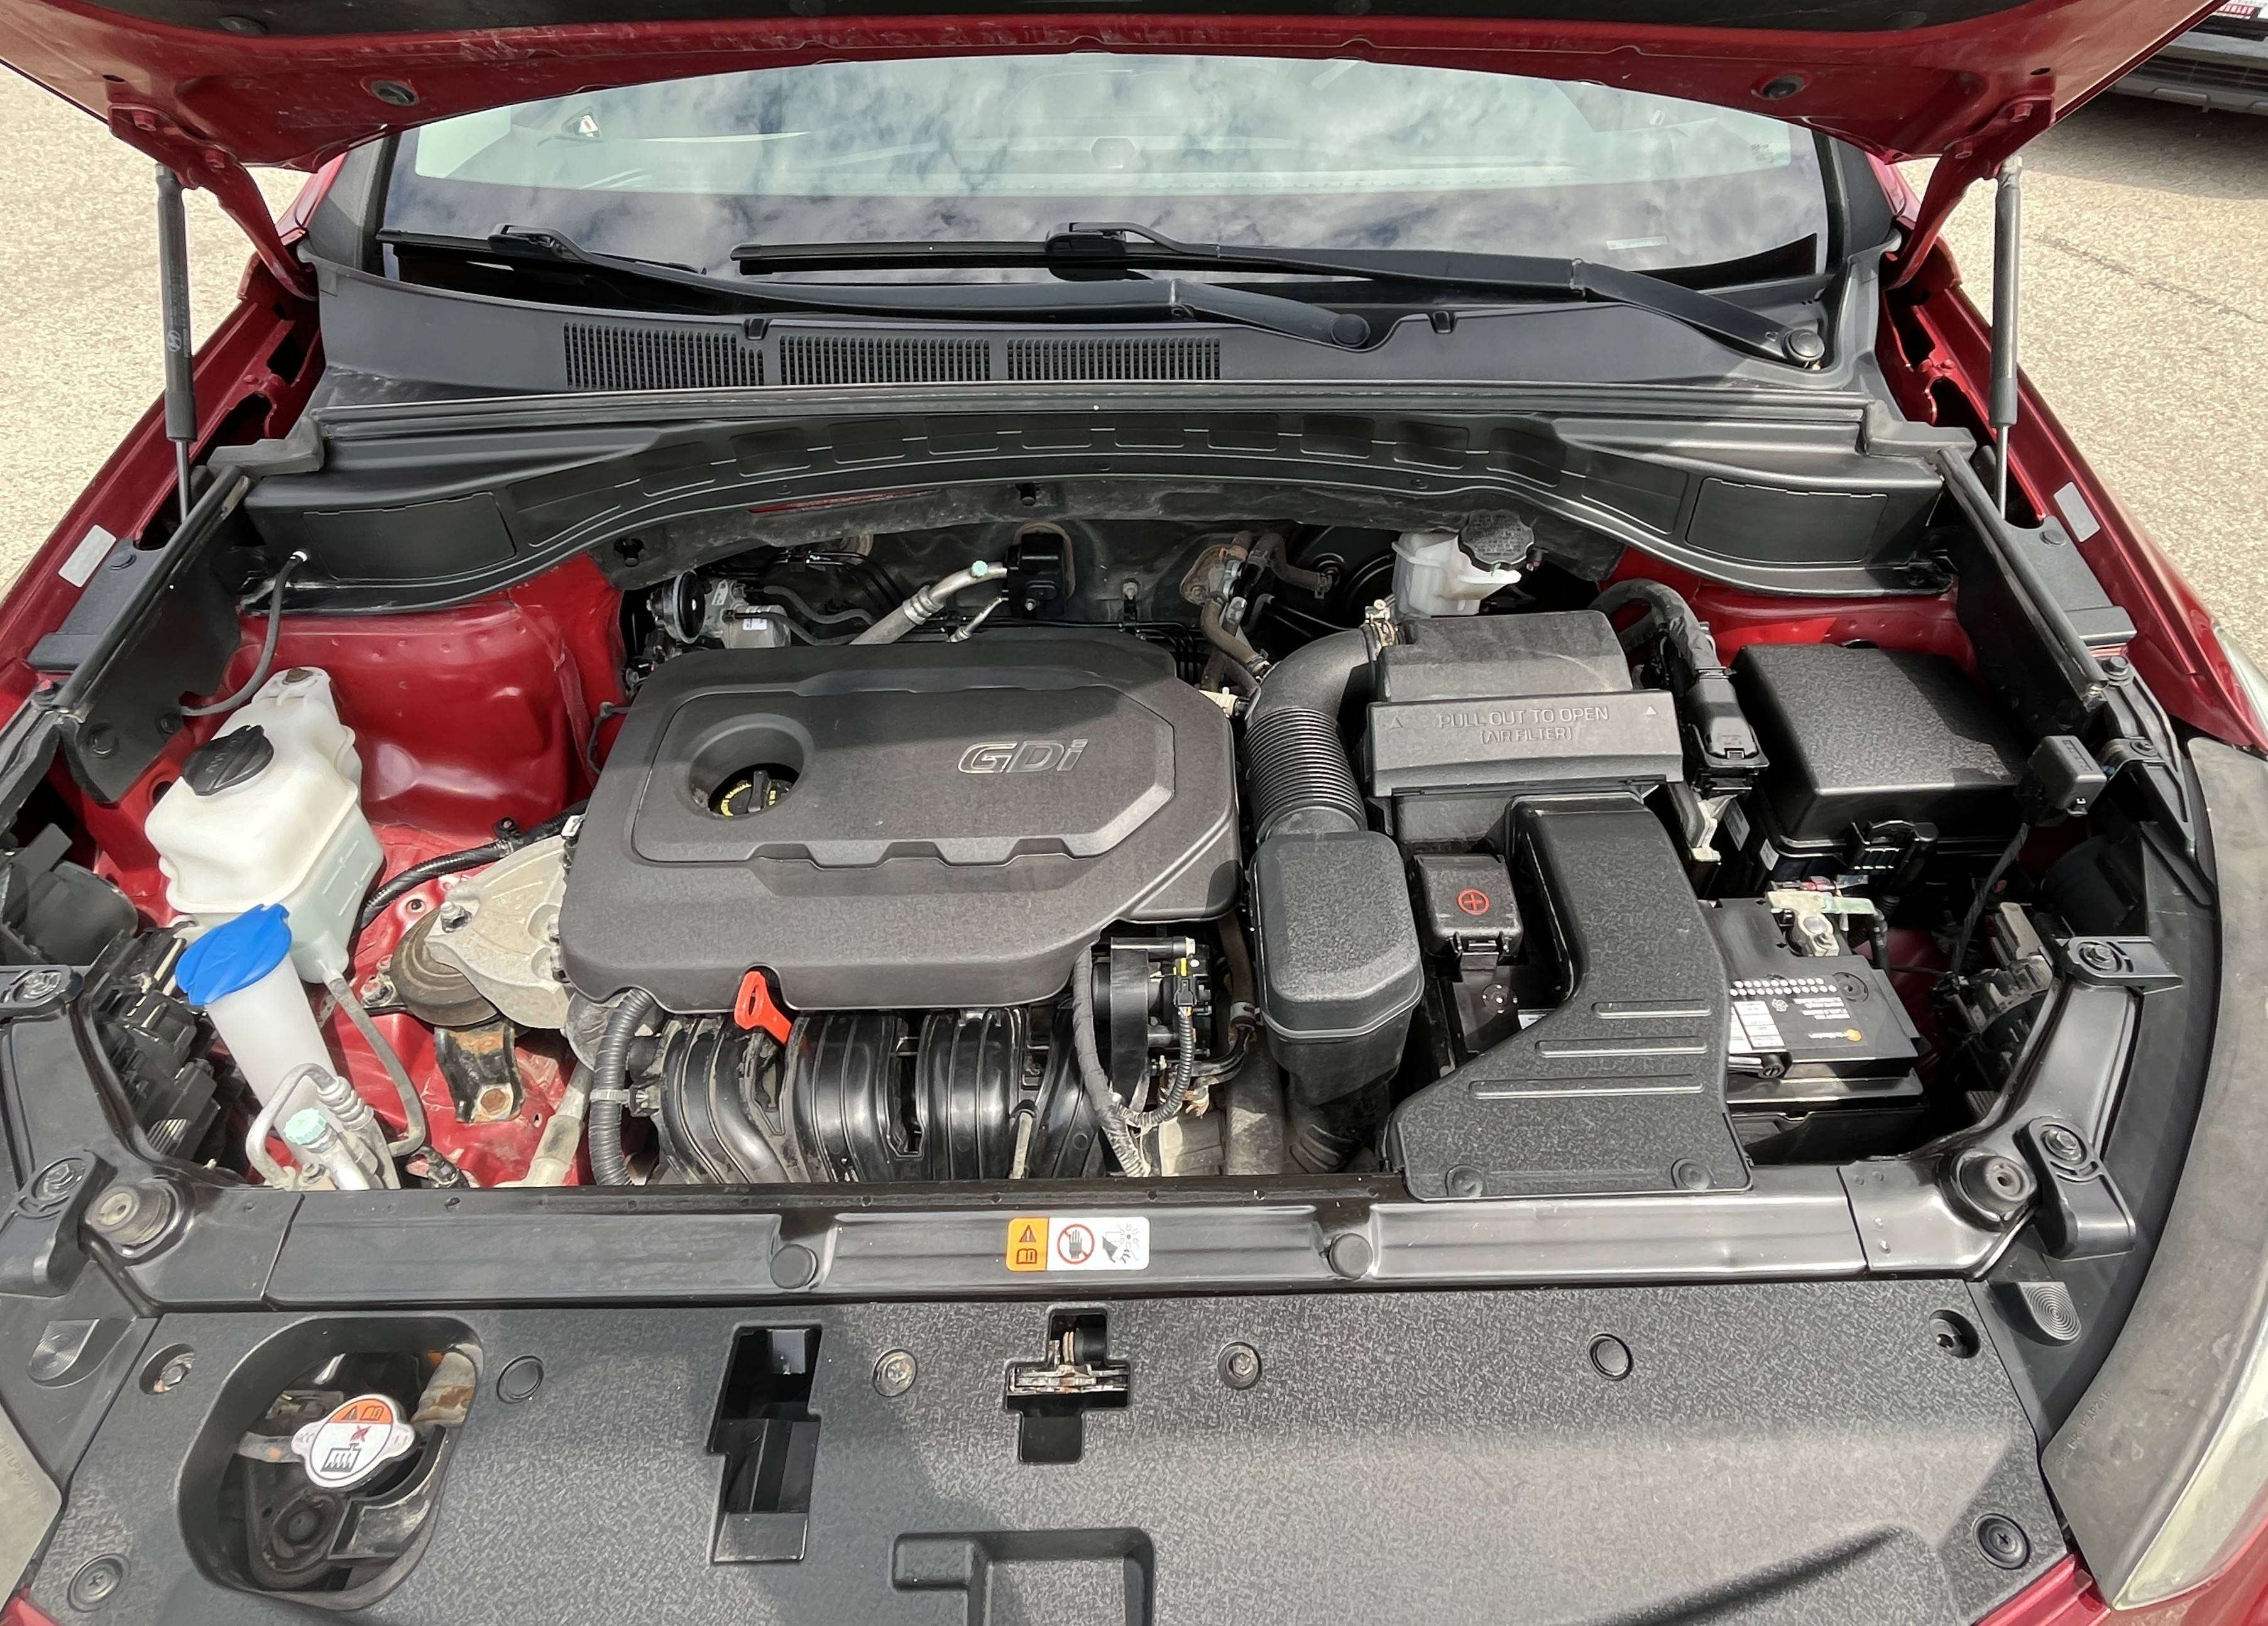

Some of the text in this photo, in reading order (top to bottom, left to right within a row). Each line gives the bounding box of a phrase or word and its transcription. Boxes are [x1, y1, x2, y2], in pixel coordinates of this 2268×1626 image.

[1438, 706, 1609, 729] PULL OUT TO OPEN
[1481, 726, 1572, 745] (AIR FILTER)
[957, 739, 1088, 773] GDi
